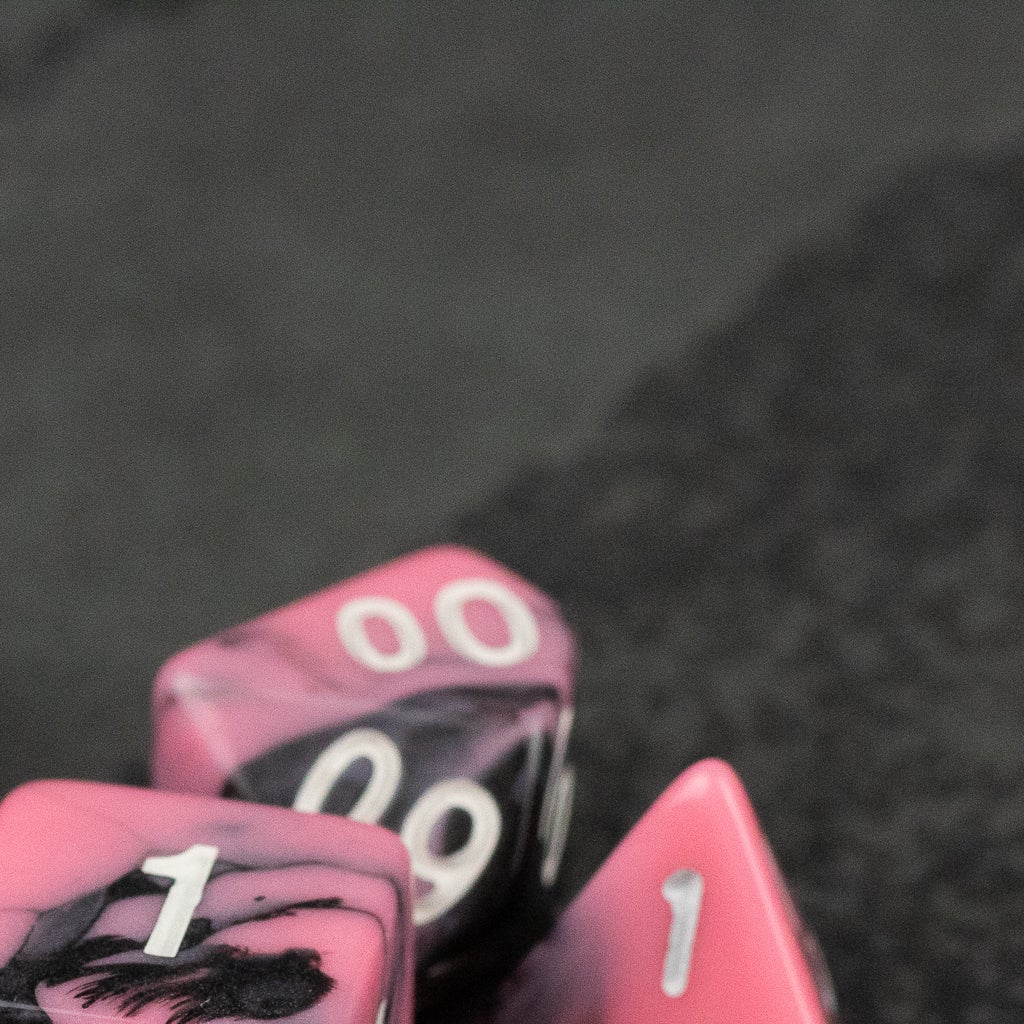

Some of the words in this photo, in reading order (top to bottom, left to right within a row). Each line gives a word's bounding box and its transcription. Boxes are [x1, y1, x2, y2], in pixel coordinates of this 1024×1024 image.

[336, 577, 540, 674] 00
[140, 844, 220, 959] 1
[661, 869, 704, 998] 1
